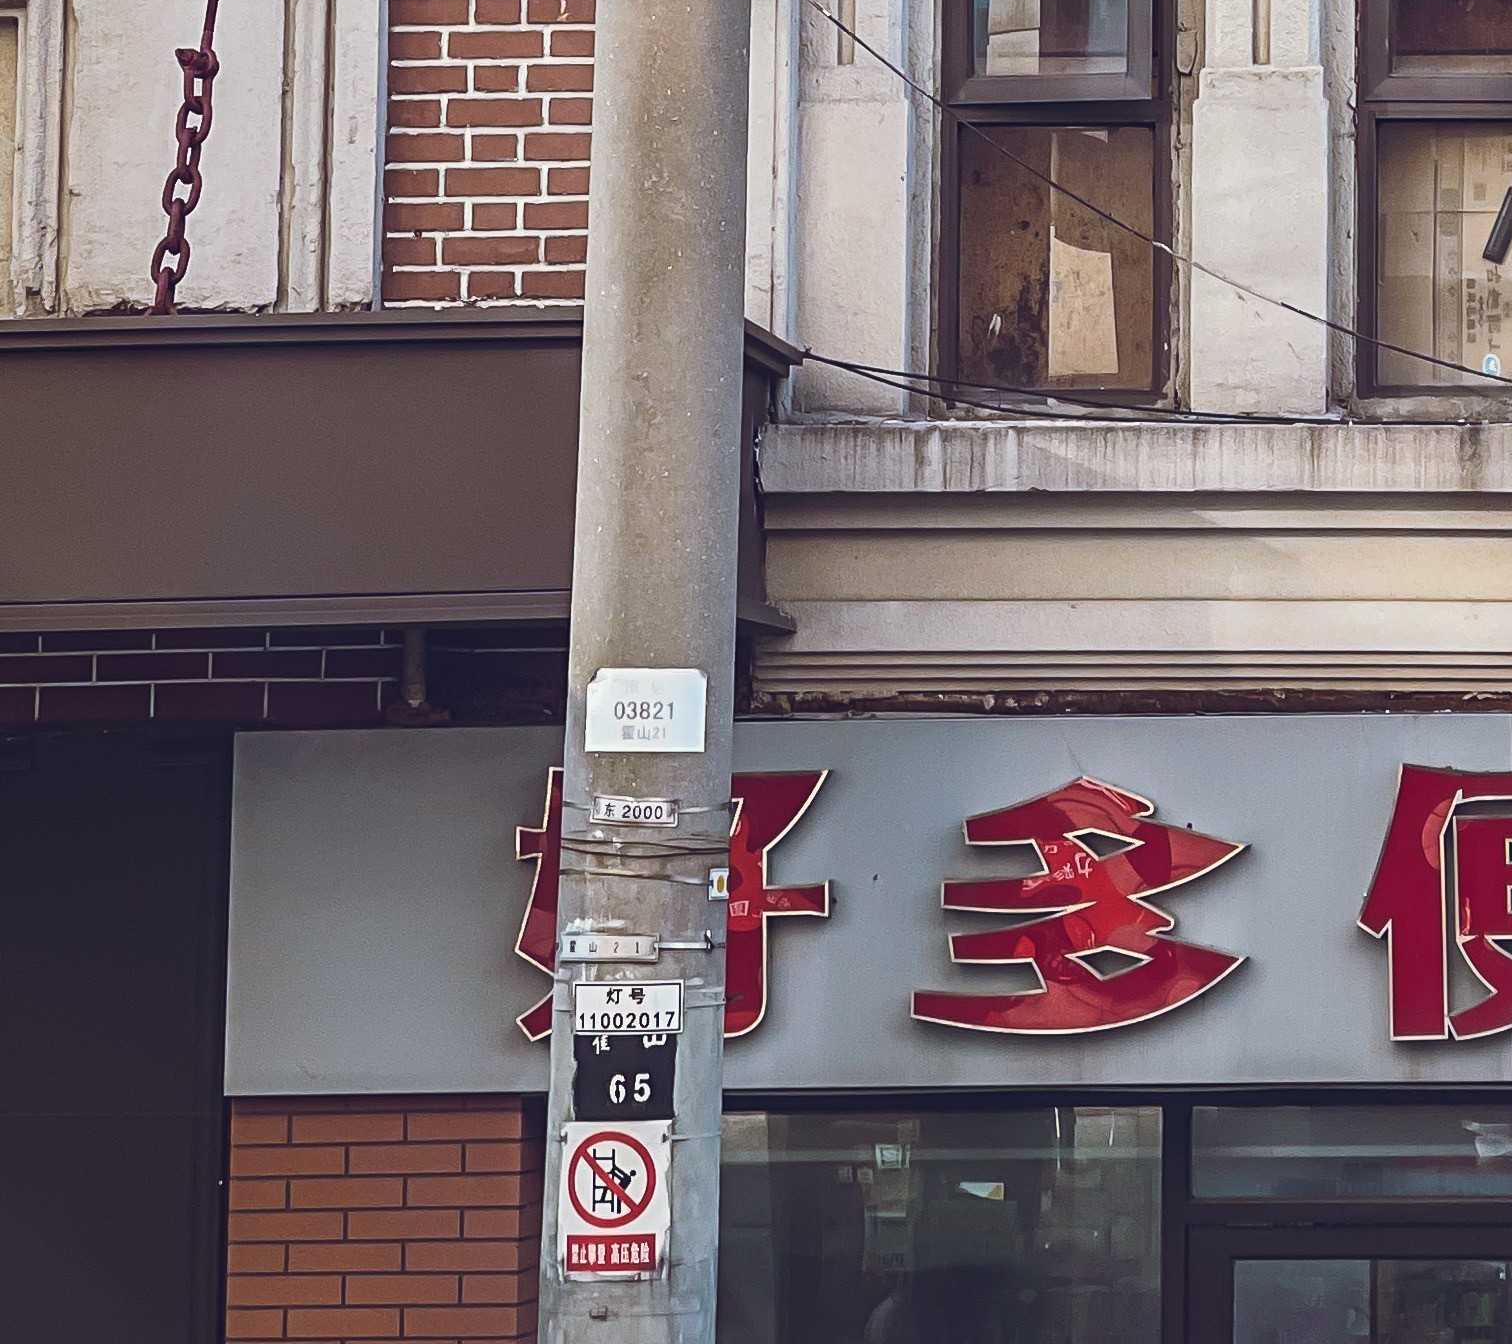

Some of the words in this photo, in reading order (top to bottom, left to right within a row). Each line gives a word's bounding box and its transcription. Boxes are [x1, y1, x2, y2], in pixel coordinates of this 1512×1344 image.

[614, 700, 674, 720] 03821
[604, 802, 616, 818] 东
[622, 804, 663, 820] 2000
[606, 987, 646, 1005] 灯号
[579, 1011, 675, 1029] 11002017
[609, 1072, 652, 1104] 65
